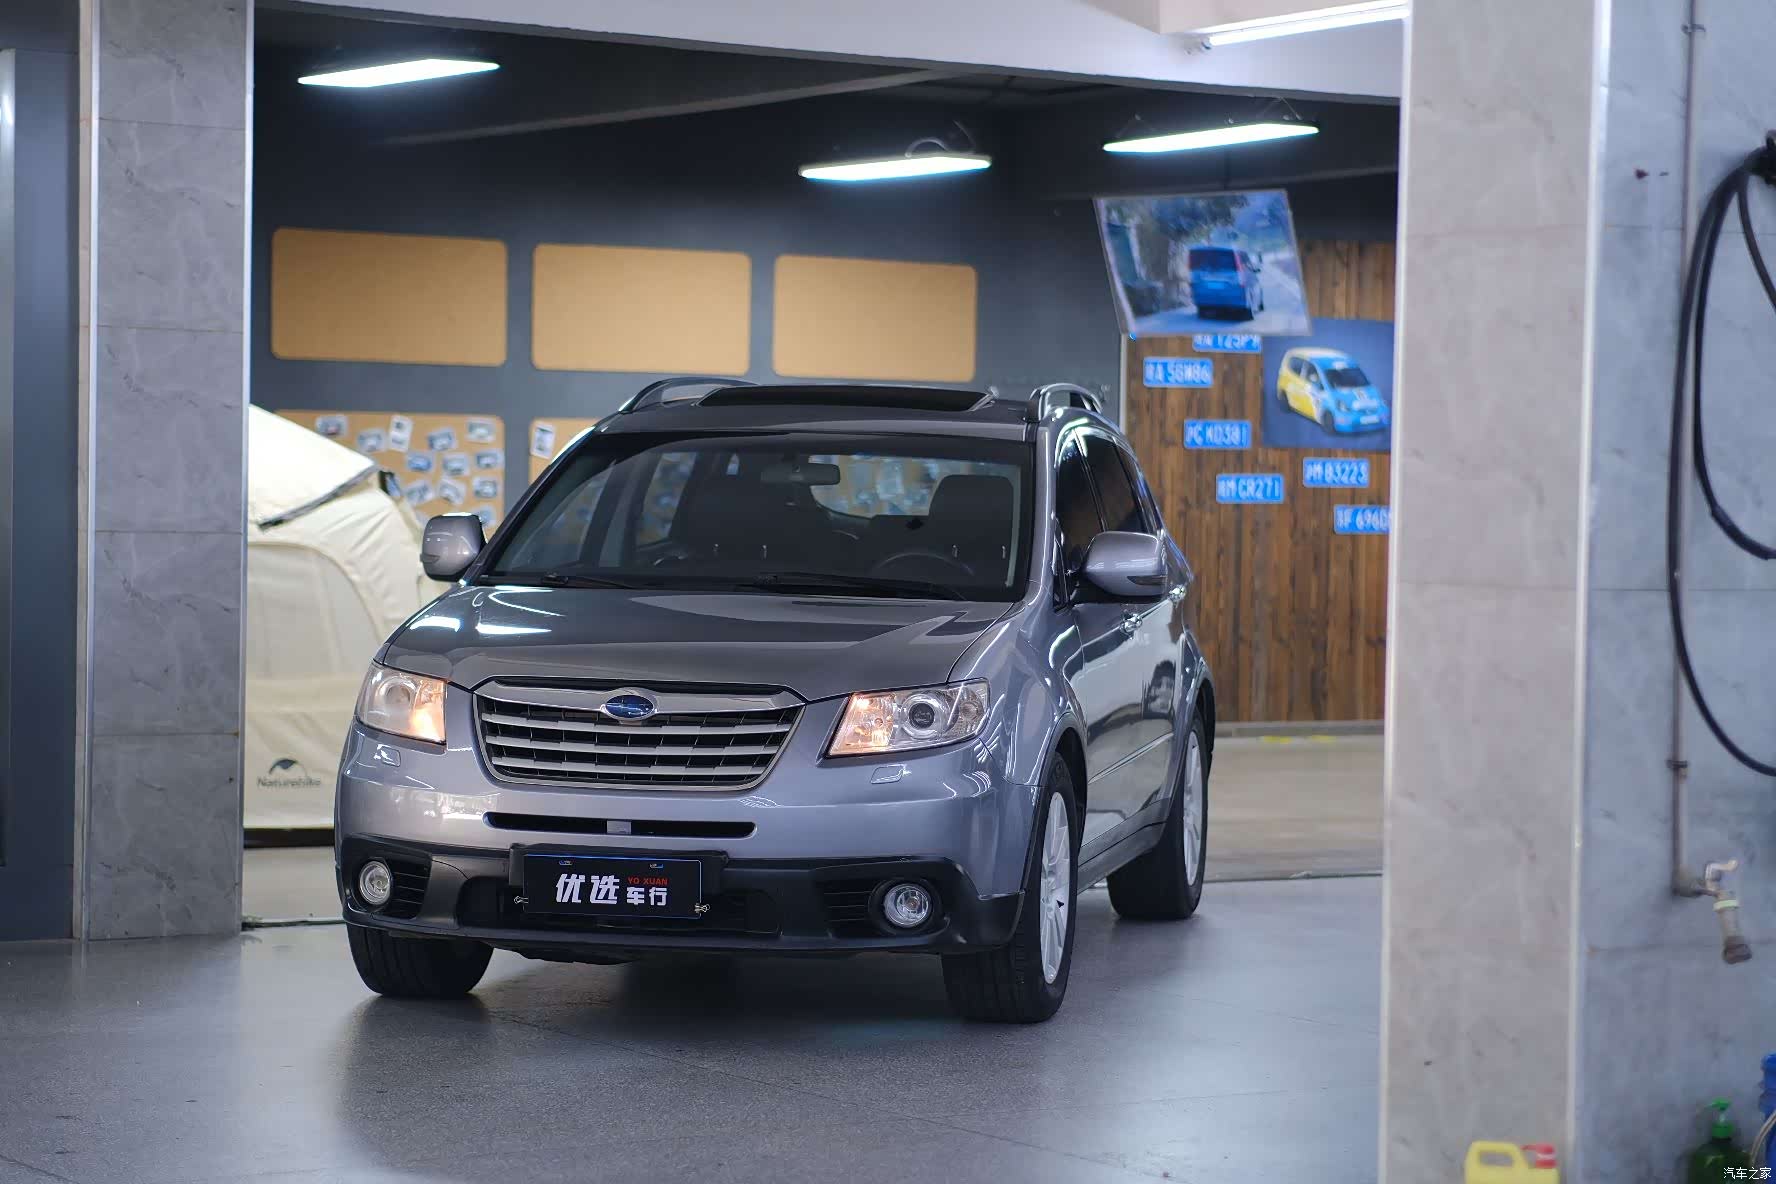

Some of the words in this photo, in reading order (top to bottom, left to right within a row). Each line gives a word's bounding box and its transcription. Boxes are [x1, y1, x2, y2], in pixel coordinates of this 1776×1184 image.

[555, 873, 620, 905] 优选
[627, 876, 640, 885] YO
[643, 877, 668, 886] XUAN
[626, 887, 668, 906] 车行
